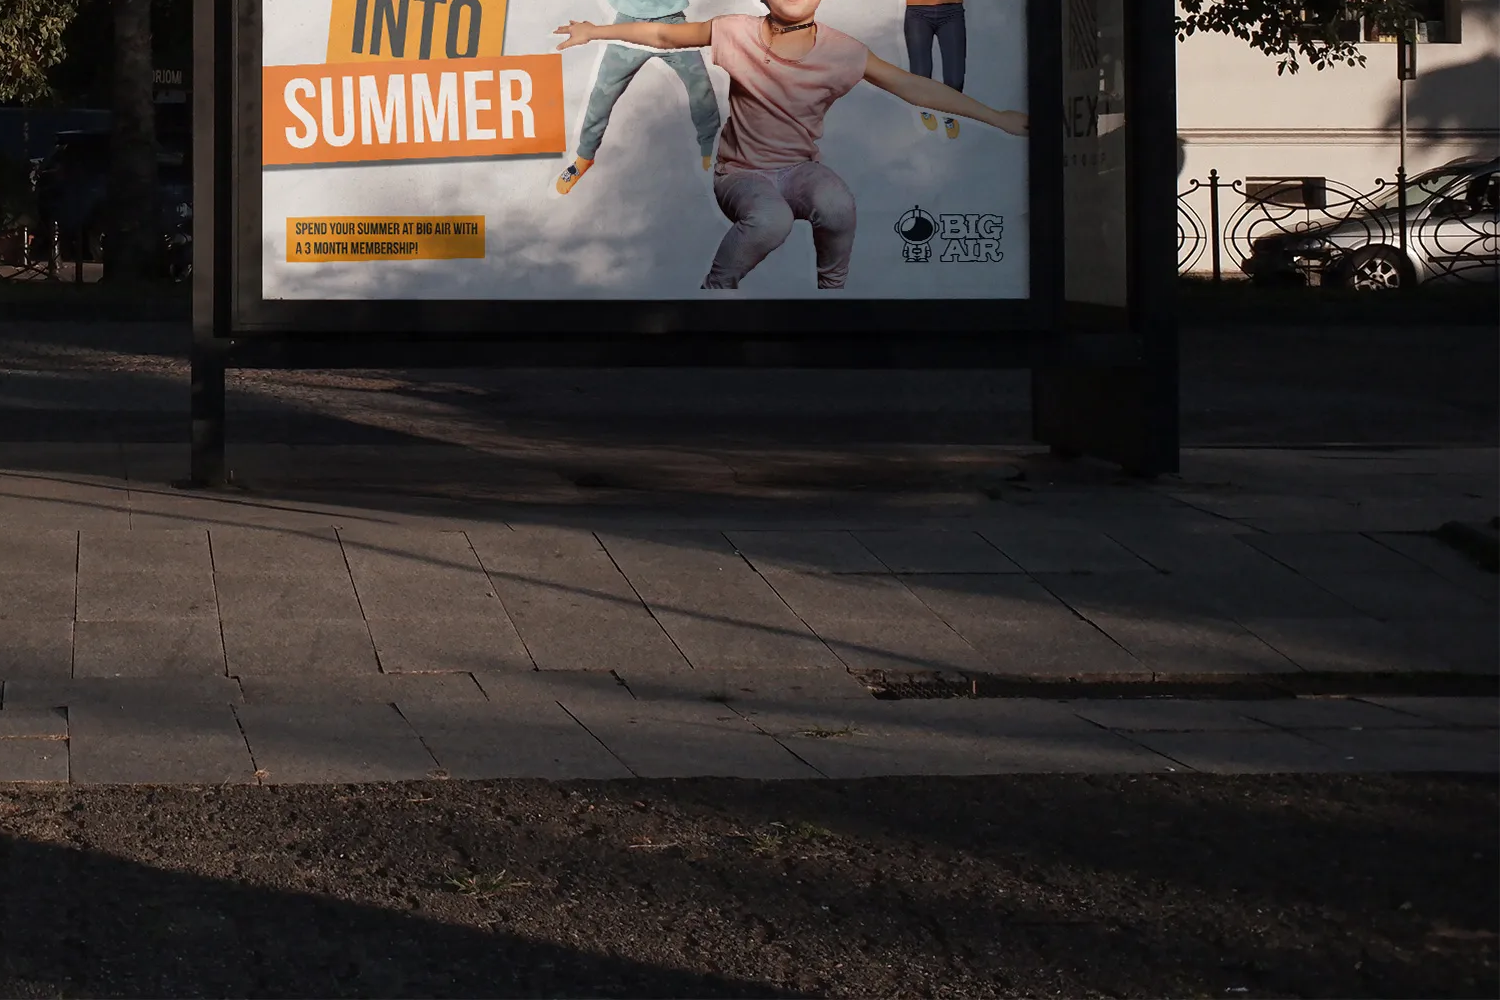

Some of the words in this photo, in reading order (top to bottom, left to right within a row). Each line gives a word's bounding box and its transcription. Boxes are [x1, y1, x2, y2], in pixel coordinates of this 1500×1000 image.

[284, 69, 536, 149] SUMMER
[295, 222, 328, 236] SPEND
[329, 222, 355, 235] YOUR
[357, 222, 400, 235] SUMMER
[402, 222, 415, 235] AT
[416, 222, 432, 235] BIG
[434, 222, 451, 235] AIR
[453, 222, 478, 235] WITH
[940, 213, 1004, 240] BIG
[295, 242, 302, 255] A
[304, 242, 311, 255] 3
[313, 242, 348, 255] MONTH
[350, 242, 419, 255] MEMBERSHIP!
[940, 237, 1004, 263] AIR
